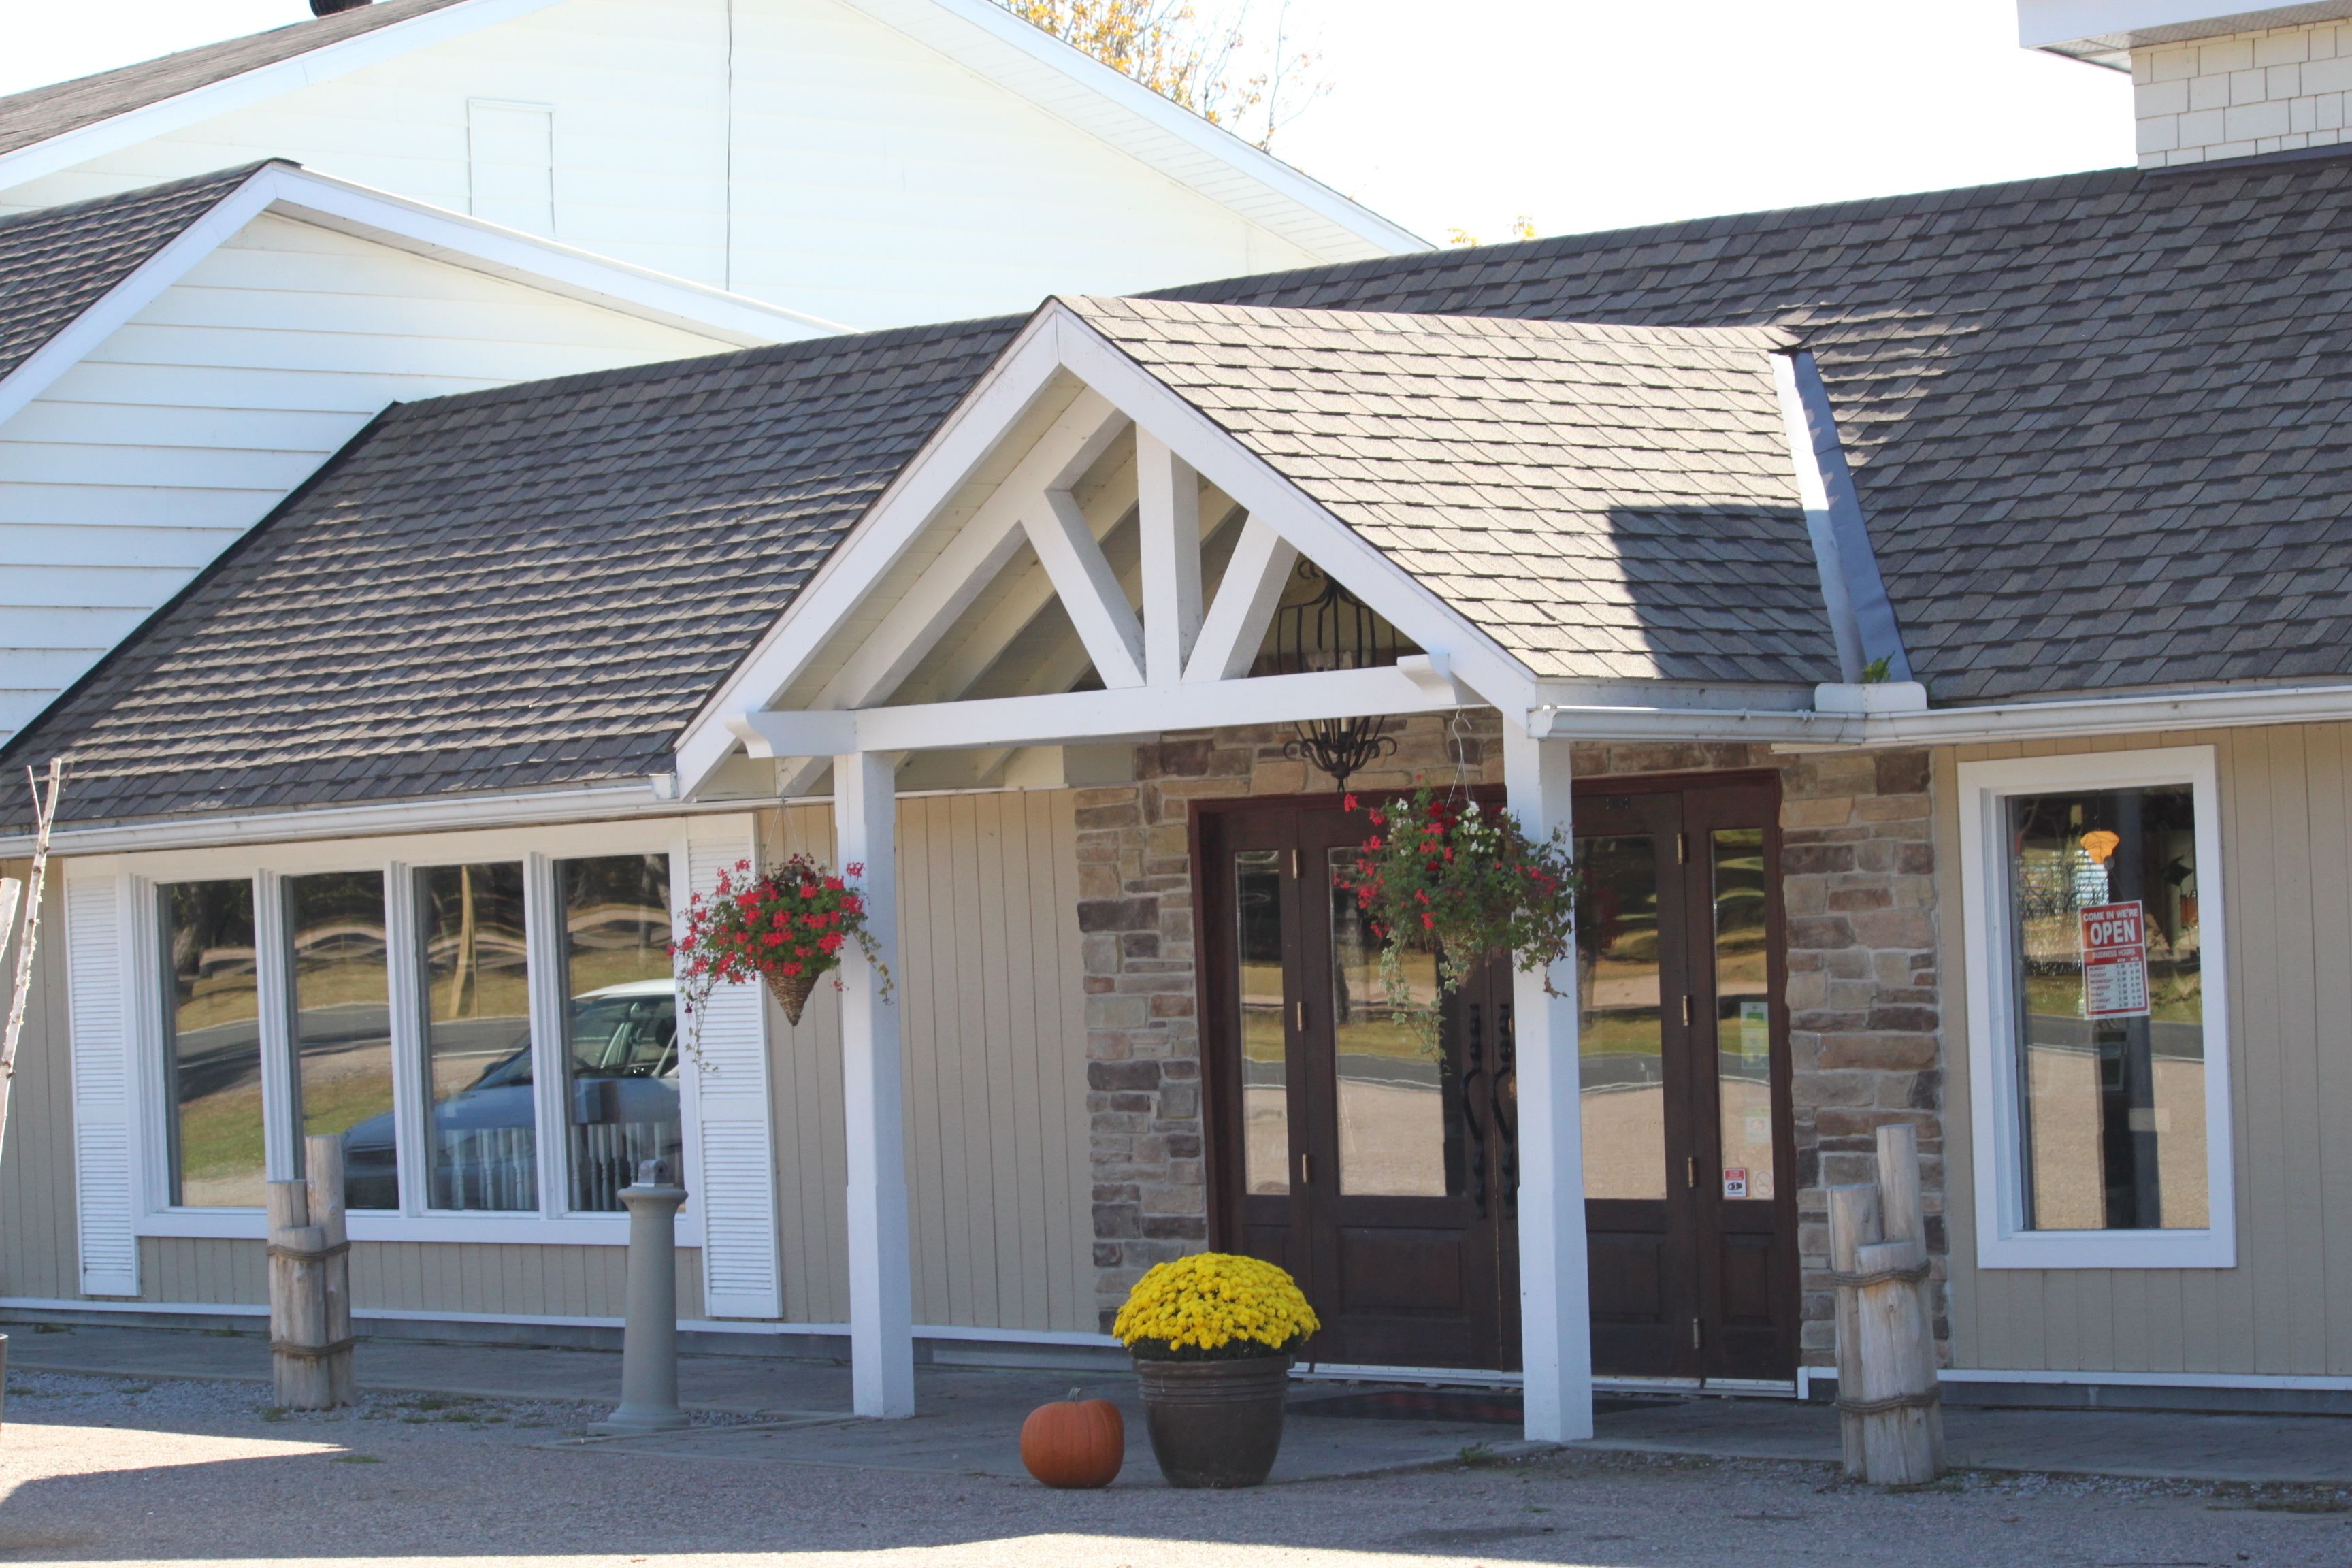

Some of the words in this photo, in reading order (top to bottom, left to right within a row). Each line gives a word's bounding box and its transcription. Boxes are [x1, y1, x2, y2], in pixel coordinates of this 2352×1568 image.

[2083, 911, 2104, 921] COME
[2106, 911, 2114, 919] IN
[2116, 908, 2138, 918] WE'RE
[2090, 919, 2136, 945] OPEN
[2093, 950, 2117, 958] BUSINESS
[2118, 948, 2136, 956] HOURS
